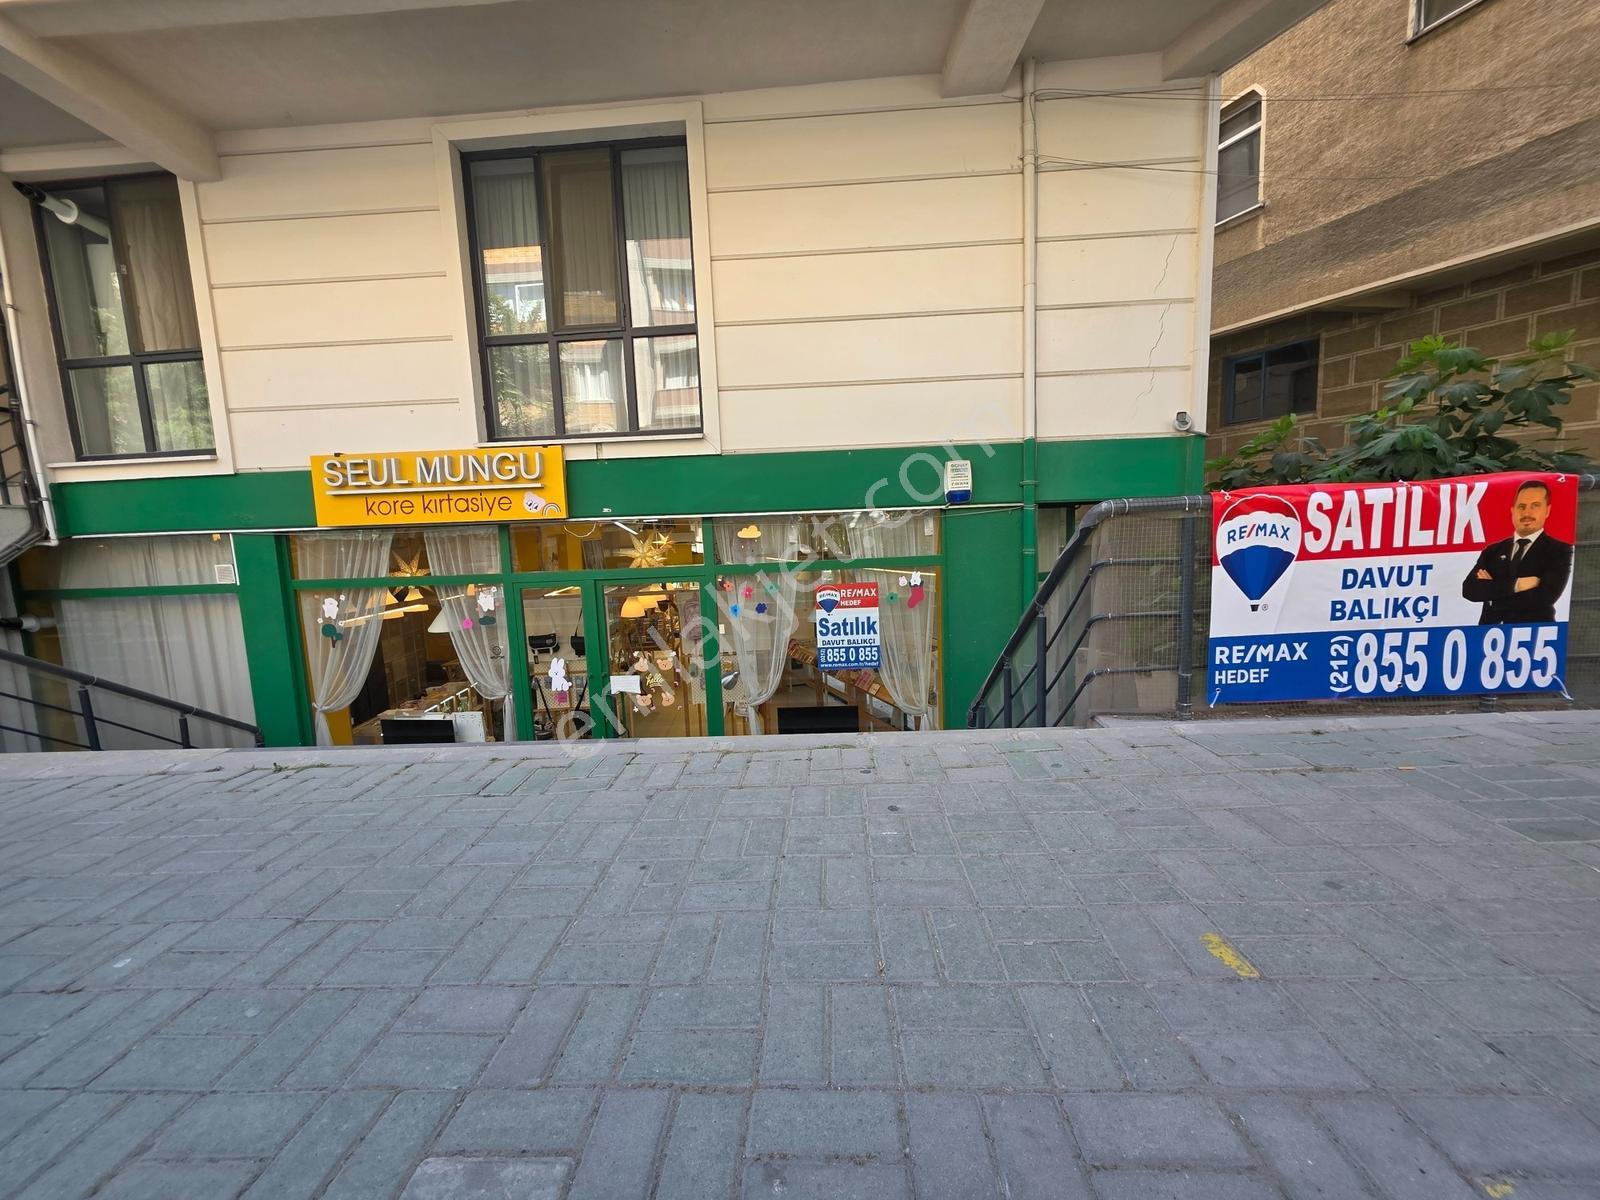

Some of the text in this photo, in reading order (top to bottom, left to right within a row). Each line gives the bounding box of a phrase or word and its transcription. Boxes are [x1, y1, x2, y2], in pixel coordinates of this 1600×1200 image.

[323, 451, 544, 488] SEUL MUNGU
[365, 491, 513, 516] kore kırtasiye
[1304, 482, 1489, 553] SATILIK
[1227, 523, 1290, 544] RE/MAX
[1341, 564, 1433, 590] DAVUT
[840, 588, 877, 598] RE/MAX
[1330, 595, 1439, 623] BALIKÇI
[818, 616, 877, 637] Satılık
[847, 638, 876, 646] BALIKÇI
[1215, 642, 1308, 665] RE/MAX
[827, 648, 846, 662] 855
[849, 648, 856, 661] 0
[858, 647, 878, 661] 855
[1329, 626, 1558, 693] (212) 855 0 855
[1215, 668, 1269, 684] HEDEF
